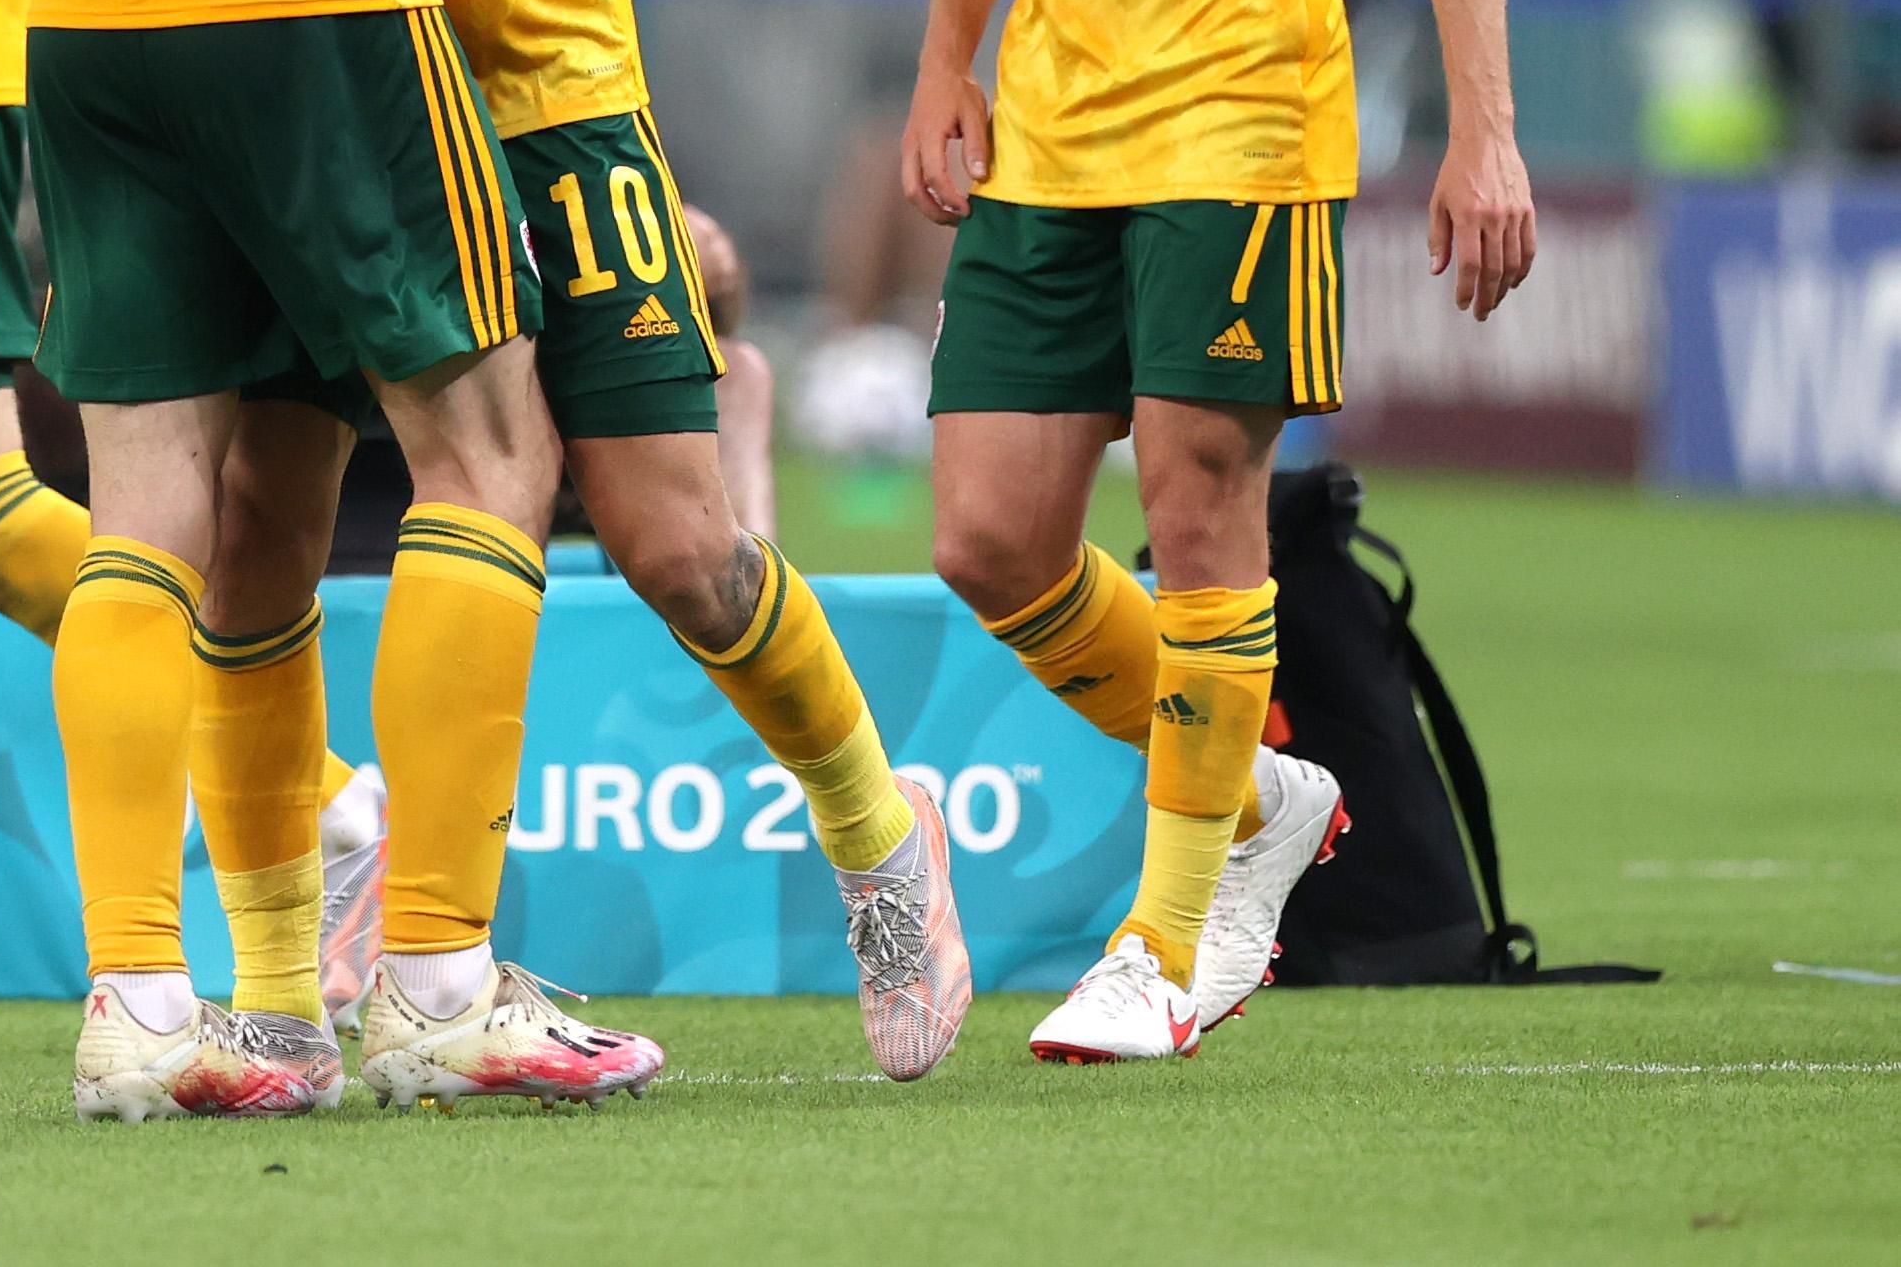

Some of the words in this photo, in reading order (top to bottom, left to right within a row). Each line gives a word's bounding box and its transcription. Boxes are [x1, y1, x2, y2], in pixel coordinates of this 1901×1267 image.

[549, 165, 668, 298] 10
[623, 320, 681, 340] adidas
[1206, 344, 1264, 362] adidas
[505, 762, 726, 853] URO
[742, 762, 1021, 854] 20
